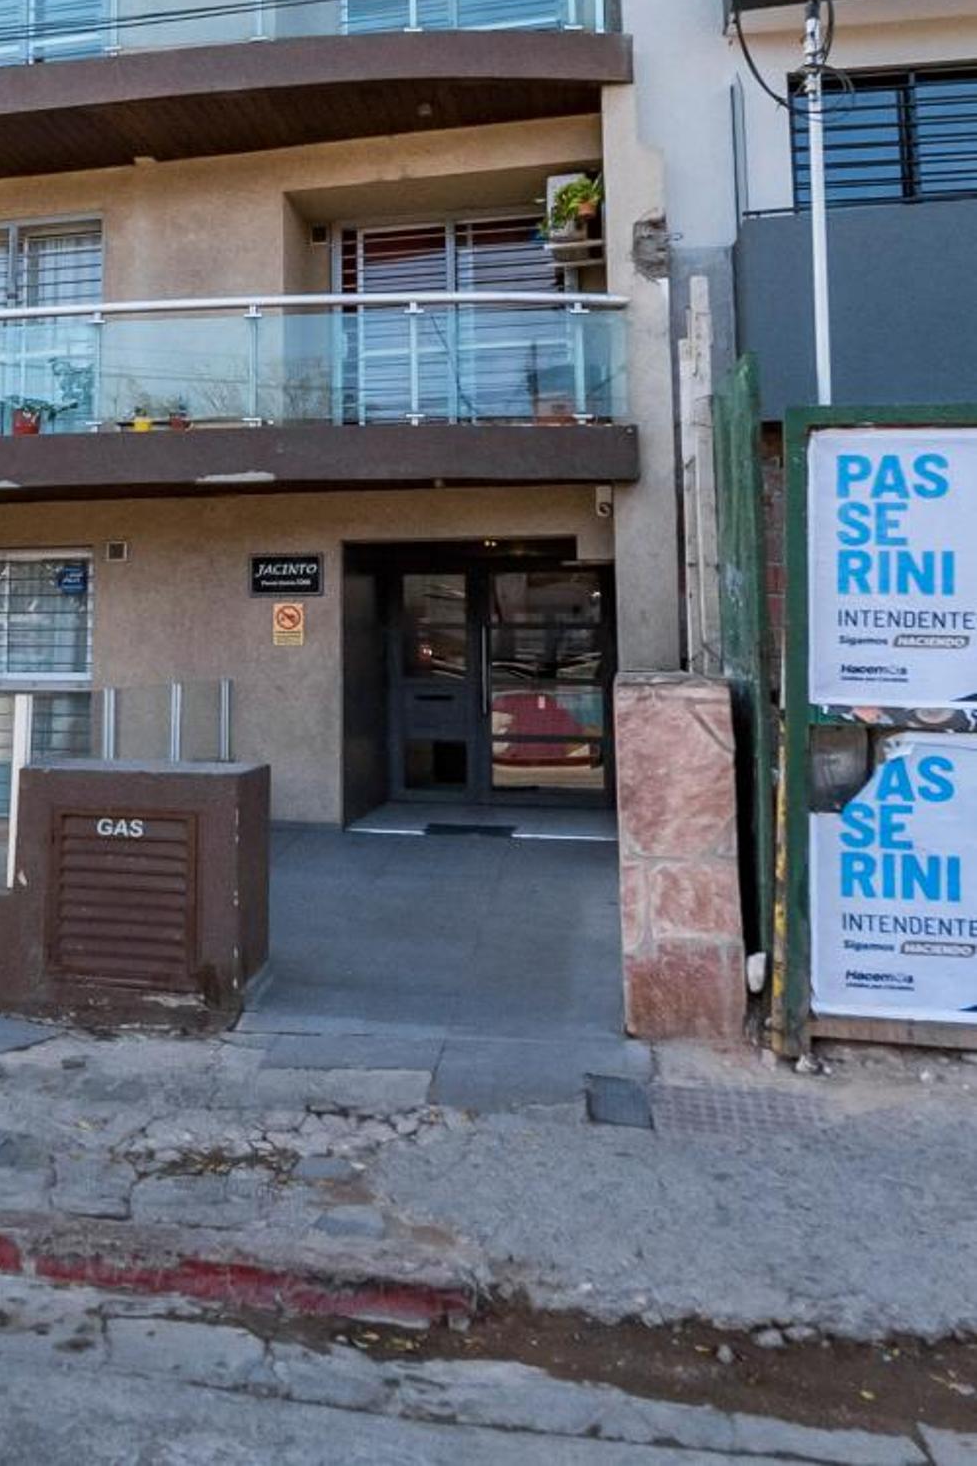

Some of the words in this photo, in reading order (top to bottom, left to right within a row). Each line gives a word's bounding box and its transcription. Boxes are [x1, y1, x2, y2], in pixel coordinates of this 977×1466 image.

[836, 453, 949, 499] PAS
[837, 501, 909, 547] SE
[255, 563, 318, 578] JACINTO
[837, 550, 956, 596] RINI
[837, 609, 976, 630] INTENDENTE
[876, 756, 954, 802] AS
[97, 818, 143, 838] GAS
[839, 801, 914, 851] SE
[841, 851, 961, 903] RINI
[842, 913, 977, 937] INTENDENTE
